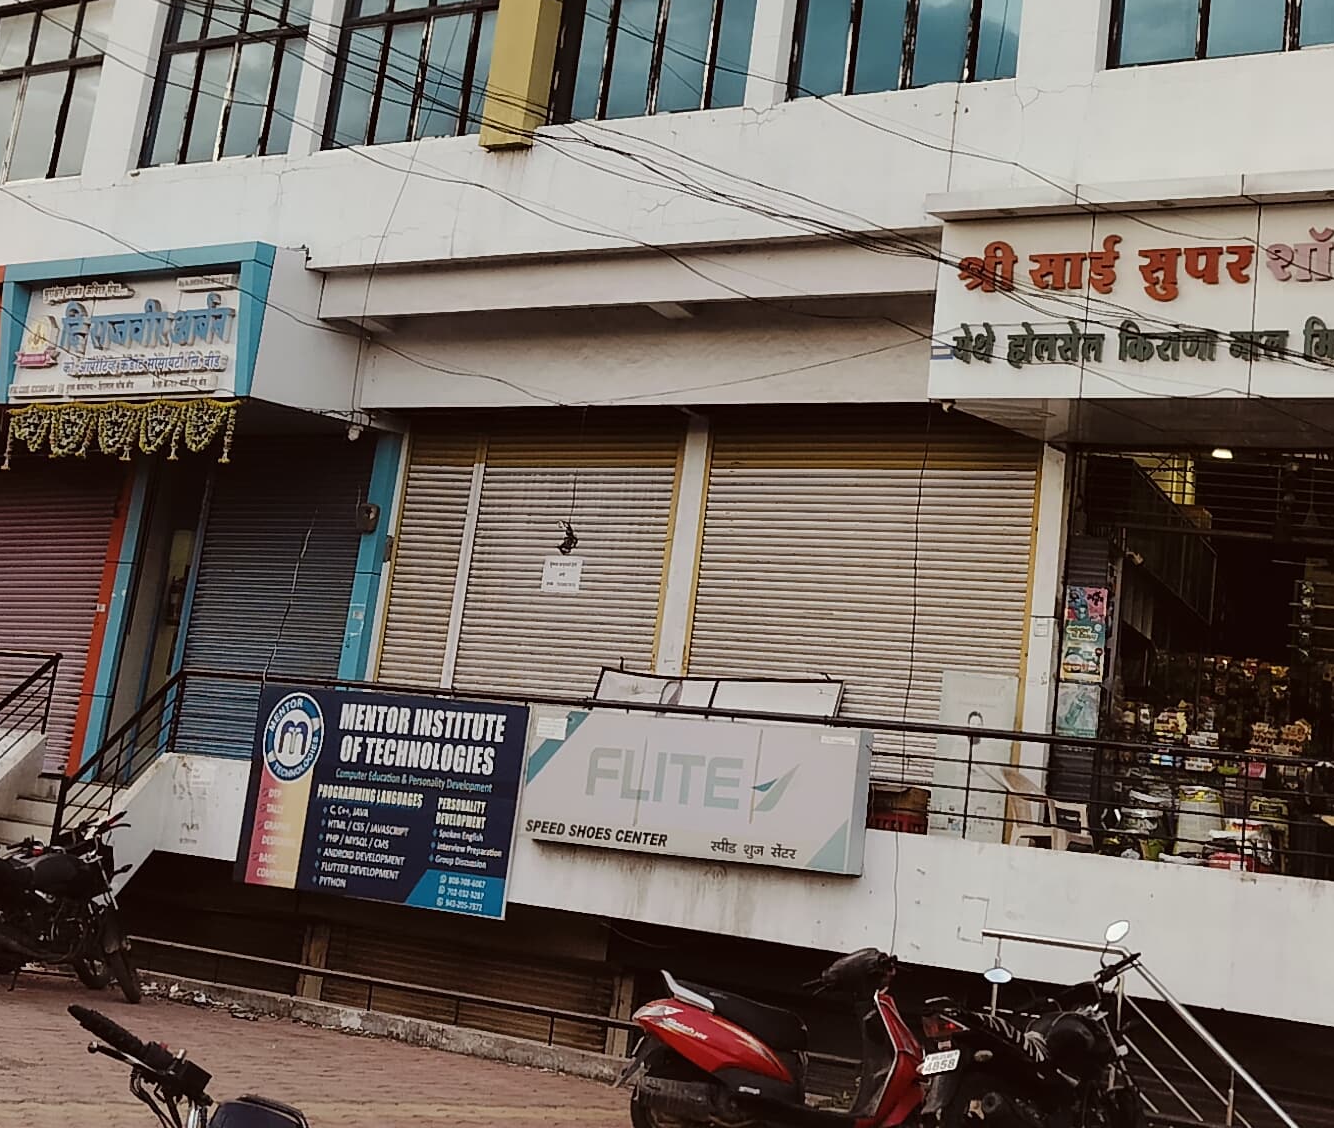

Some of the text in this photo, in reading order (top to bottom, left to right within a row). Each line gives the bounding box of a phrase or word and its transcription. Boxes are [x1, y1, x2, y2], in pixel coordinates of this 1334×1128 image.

[957, 241, 1019, 294] श्री
[1029, 235, 1124, 294] साई
[1138, 243, 1255, 302] सुपर
[953, 322, 996, 364] येथे
[1007, 321, 1105, 369] होलसेल
[1119, 320, 1218, 362] किराणा
[1229, 330, 1290, 362] माल
[269, 698, 304, 732] MENTOR
[339, 703, 507, 743] MENTOR INSTITUTE
[340, 735, 496, 776] OF TECHNOLOGIES
[335, 768, 493, 794] Computer Education & Personality Development
[585, 747, 744, 810] FLITE
[317, 784, 424, 808] PROGRAMMING LANGUAGES
[437, 797, 487, 814] PERSONALITY
[328, 819, 346, 830] HTML
[352, 822, 365, 832] CSS
[435, 812, 486, 829] DEVELOPMENT
[438, 829, 484, 843] Spoken English
[526, 819, 668, 848] SPEED SHOES CENTER
[355, 852, 406, 866] DEVELOPMENT
[710, 837, 737, 854] स्पीड
[743, 843, 764, 859] शुज
[320, 862, 400, 880] FLUTTER DEVELOPMENT
[435, 855, 454, 866] Group
[318, 875, 347, 888] PYTHON
